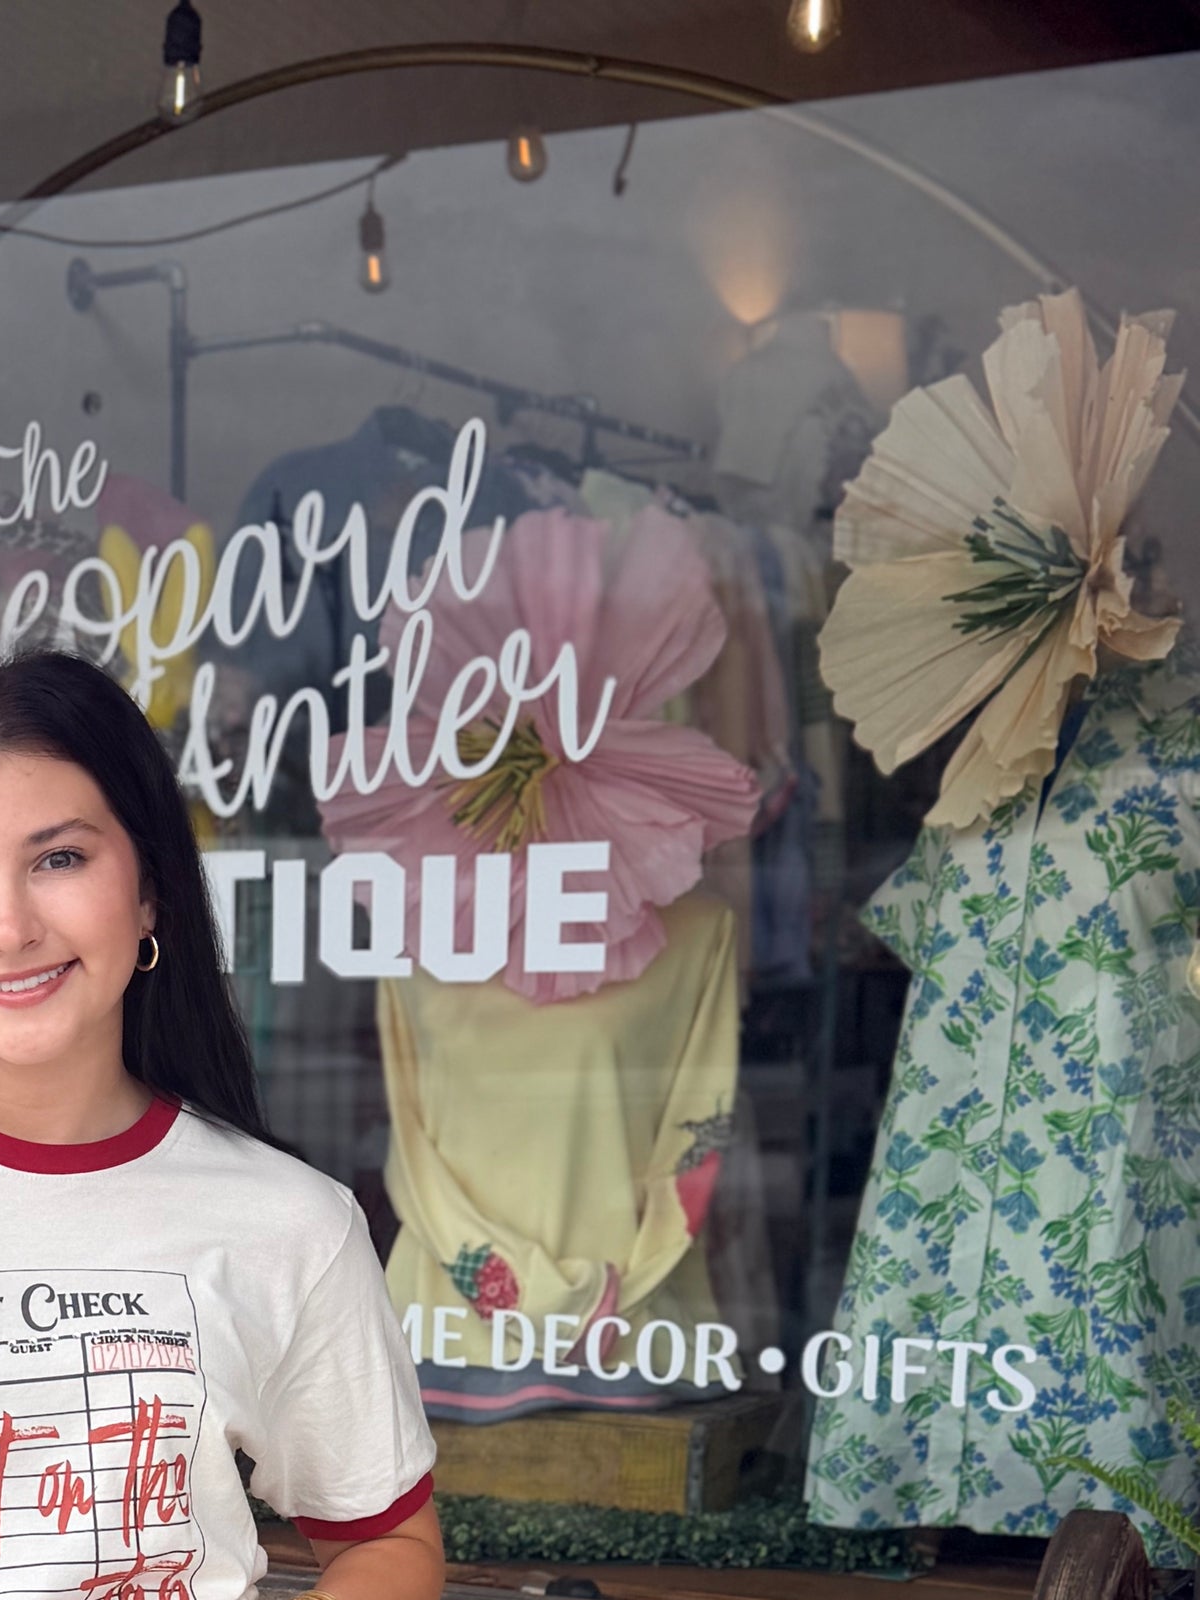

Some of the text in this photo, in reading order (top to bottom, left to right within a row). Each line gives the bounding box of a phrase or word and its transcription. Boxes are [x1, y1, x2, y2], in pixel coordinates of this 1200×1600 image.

[177, 609, 616, 817] Antler
[199, 841, 610, 984] TIQUE
[10, 1343, 53, 1355] GUEST
[137, 1334, 191, 1349] NUMBER
[21, 1283, 149, 1332] CHECK
[492, 1308, 742, 1391] DECOR
[802, 1330, 1038, 1412] GIFTS
[38, 1459, 99, 1534] on
